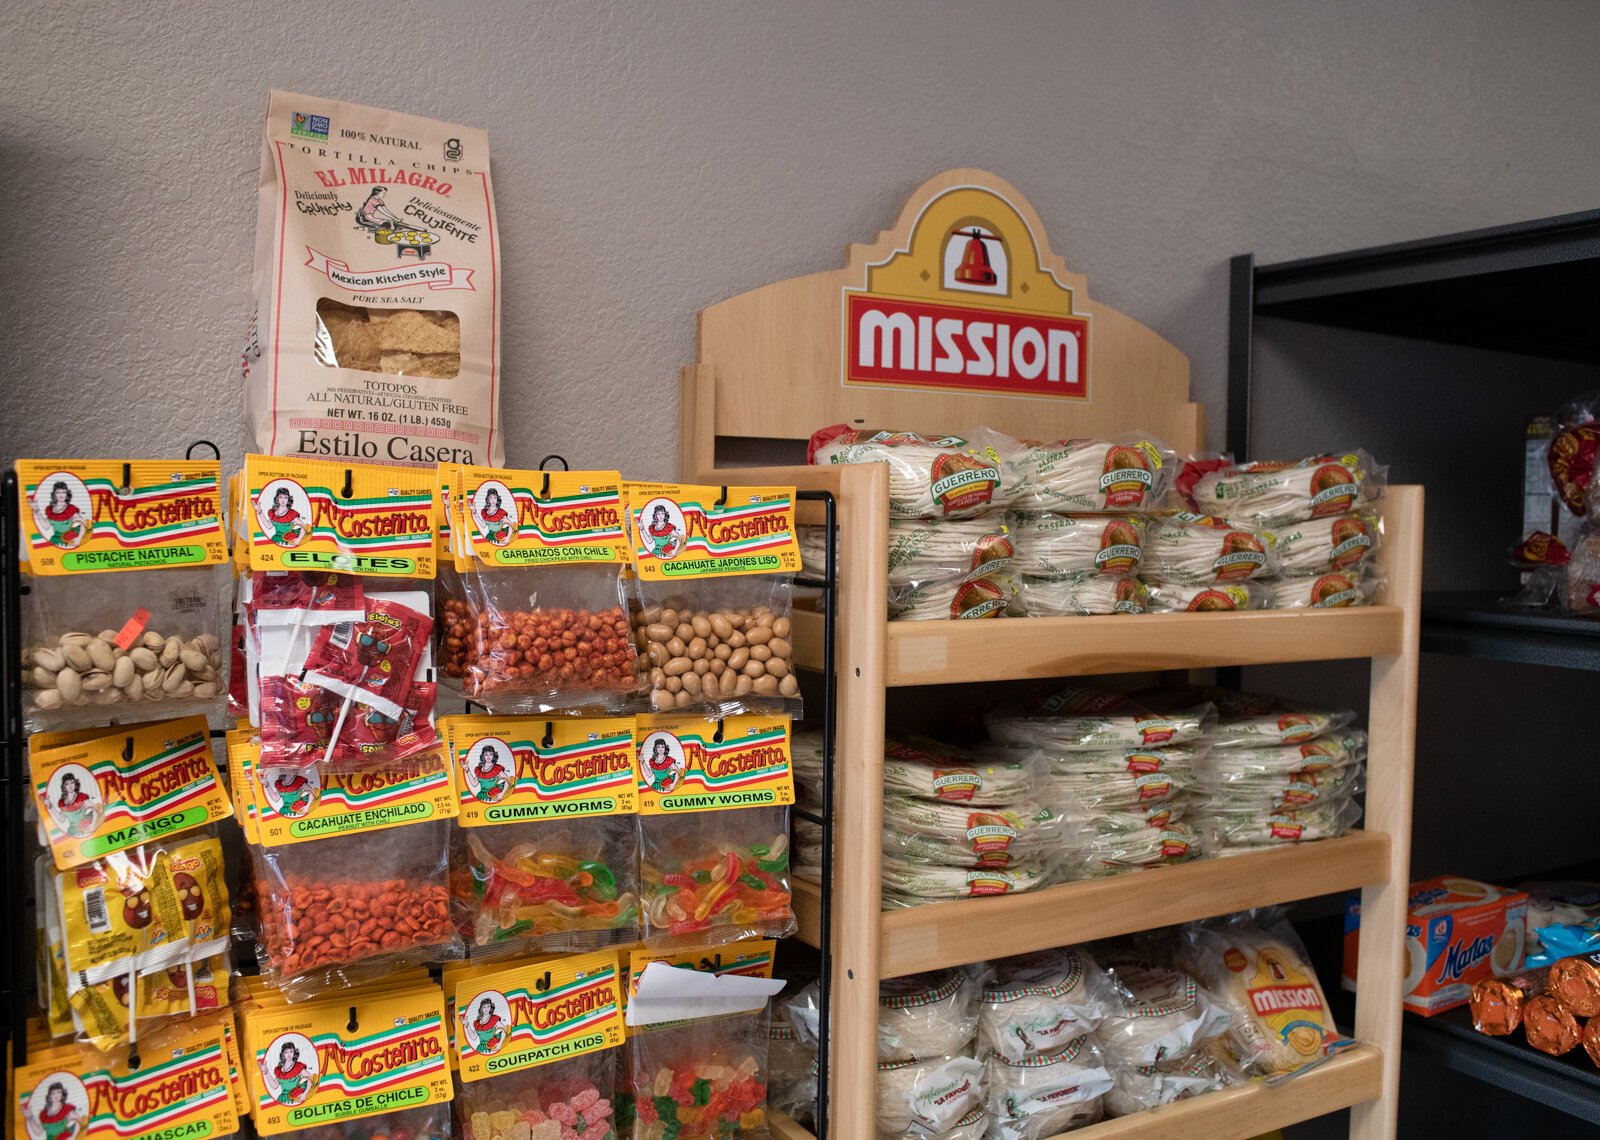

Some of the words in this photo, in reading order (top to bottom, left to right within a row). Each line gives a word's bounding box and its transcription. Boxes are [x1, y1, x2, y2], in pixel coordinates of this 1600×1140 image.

[311, 121, 328, 129] GMO
[312, 116, 329, 124] NON
[292, 128, 328, 140] VERIFIED
[340, 129, 366, 141] 100%
[369, 134, 422, 150] NATURAL
[287, 142, 395, 166] TORTILLA
[412, 161, 473, 175] CHIPS
[313, 170, 347, 188] EL
[347, 167, 453, 196] MILAGRO
[294, 190, 338, 201] Deliciously
[403, 204, 479, 244] CRUJIENTE
[409, 196, 481, 233] Deliciosamente
[331, 271, 374, 286] Mexican
[376, 271, 417, 285] Kitchen
[419, 267, 446, 280] Style
[352, 295, 379, 303] PURE
[380, 296, 399, 304] SEA
[400, 296, 425, 304] SALT
[859, 309, 1079, 384] MISSION
[363, 380, 418, 395] TOTOPOS
[307, 392, 331, 403] ALL
[334, 393, 440, 412] NATURAL/GLUTEN
[441, 405, 469, 416] FREE
[327, 408, 345, 419] NET
[346, 409, 365, 420] WT.
[368, 411, 379, 422] 16
[380, 412, 396, 423] OZ.
[399, 413, 408, 425] (1
[410, 414, 429, 427] LB.)
[430, 416, 452, 428] 453g
[296, 430, 378, 458] Estilo
[386, 437, 475, 466] Casera
[934, 470, 996, 494] GUERRERO
[1103, 471, 1150, 485] GUERRERO
[1313, 484, 1355, 505] GUERRERO
[95, 491, 120, 524] Mi
[119, 497, 215, 532] Costeñita
[313, 499, 338, 528] Mi
[338, 511, 432, 539] Costeñita
[520, 497, 539, 526] Mi
[538, 507, 620, 533] Costeñita
[688, 510, 708, 538] Mi
[707, 514, 789, 544] Costeñita
[1038, 520, 1076, 531] CASERAS
[76, 551, 135, 564] PISTACHE
[138, 547, 194, 560] NATURAL
[502, 549, 560, 560] GARBANZOS
[564, 549, 582, 557] CON
[583, 547, 609, 556] CHILE
[1099, 546, 1140, 560] GUERRERO
[1332, 536, 1369, 556] GUERRERO
[260, 554, 274, 562] 424
[290, 552, 410, 570] ELOTES
[663, 560, 716, 572] CACAHUATE
[717, 558, 757, 569] JAPONES
[759, 556, 778, 565] LISO
[1218, 553, 1264, 565] GUERRERO
[645, 565, 656, 573] 543
[517, 749, 540, 780] Mi
[540, 751, 630, 786] Costeñita
[686, 742, 707, 771] Mi
[706, 746, 786, 778] Costeñita
[935, 775, 980, 787] GUERRERO
[488, 804, 557, 819] GUMMY
[557, 800, 613, 813] WORMS
[643, 800, 655, 808] 419
[662, 796, 720, 808] GUMMY
[719, 792, 773, 804] WORMS
[298, 814, 362, 832] CACAHUATE
[364, 803, 426, 821] ENCHILADO
[338, 822, 360, 831] PEANUT
[360, 820, 375, 828] WITH
[375, 818, 391, 826] CHILI
[466, 811, 479, 819] 419
[106, 813, 186, 845] MANGO
[269, 827, 283, 837] 501
[968, 825, 1015, 838] GUERRERO
[512, 995, 533, 1026] Mi
[533, 987, 615, 1030] Costeñita
[1252, 987, 1320, 1012] MISSION
[408, 1014, 424, 1024] QUALITY
[424, 1010, 440, 1019] SNACKS
[321, 1042, 346, 1076] Mi
[346, 1036, 442, 1080] Costeñita
[487, 1043, 570, 1071] SOURPATCH
[574, 1035, 604, 1049] KIDS
[468, 1064, 480, 1073] 422
[119, 1066, 223, 1119] Costeñita
[293, 1102, 352, 1120] BOLITAS
[355, 1095, 375, 1108] DE
[376, 1087, 424, 1105] CHICLE
[267, 1116, 281, 1125] 493
[141, 1121, 207, 1140] MASCAR
